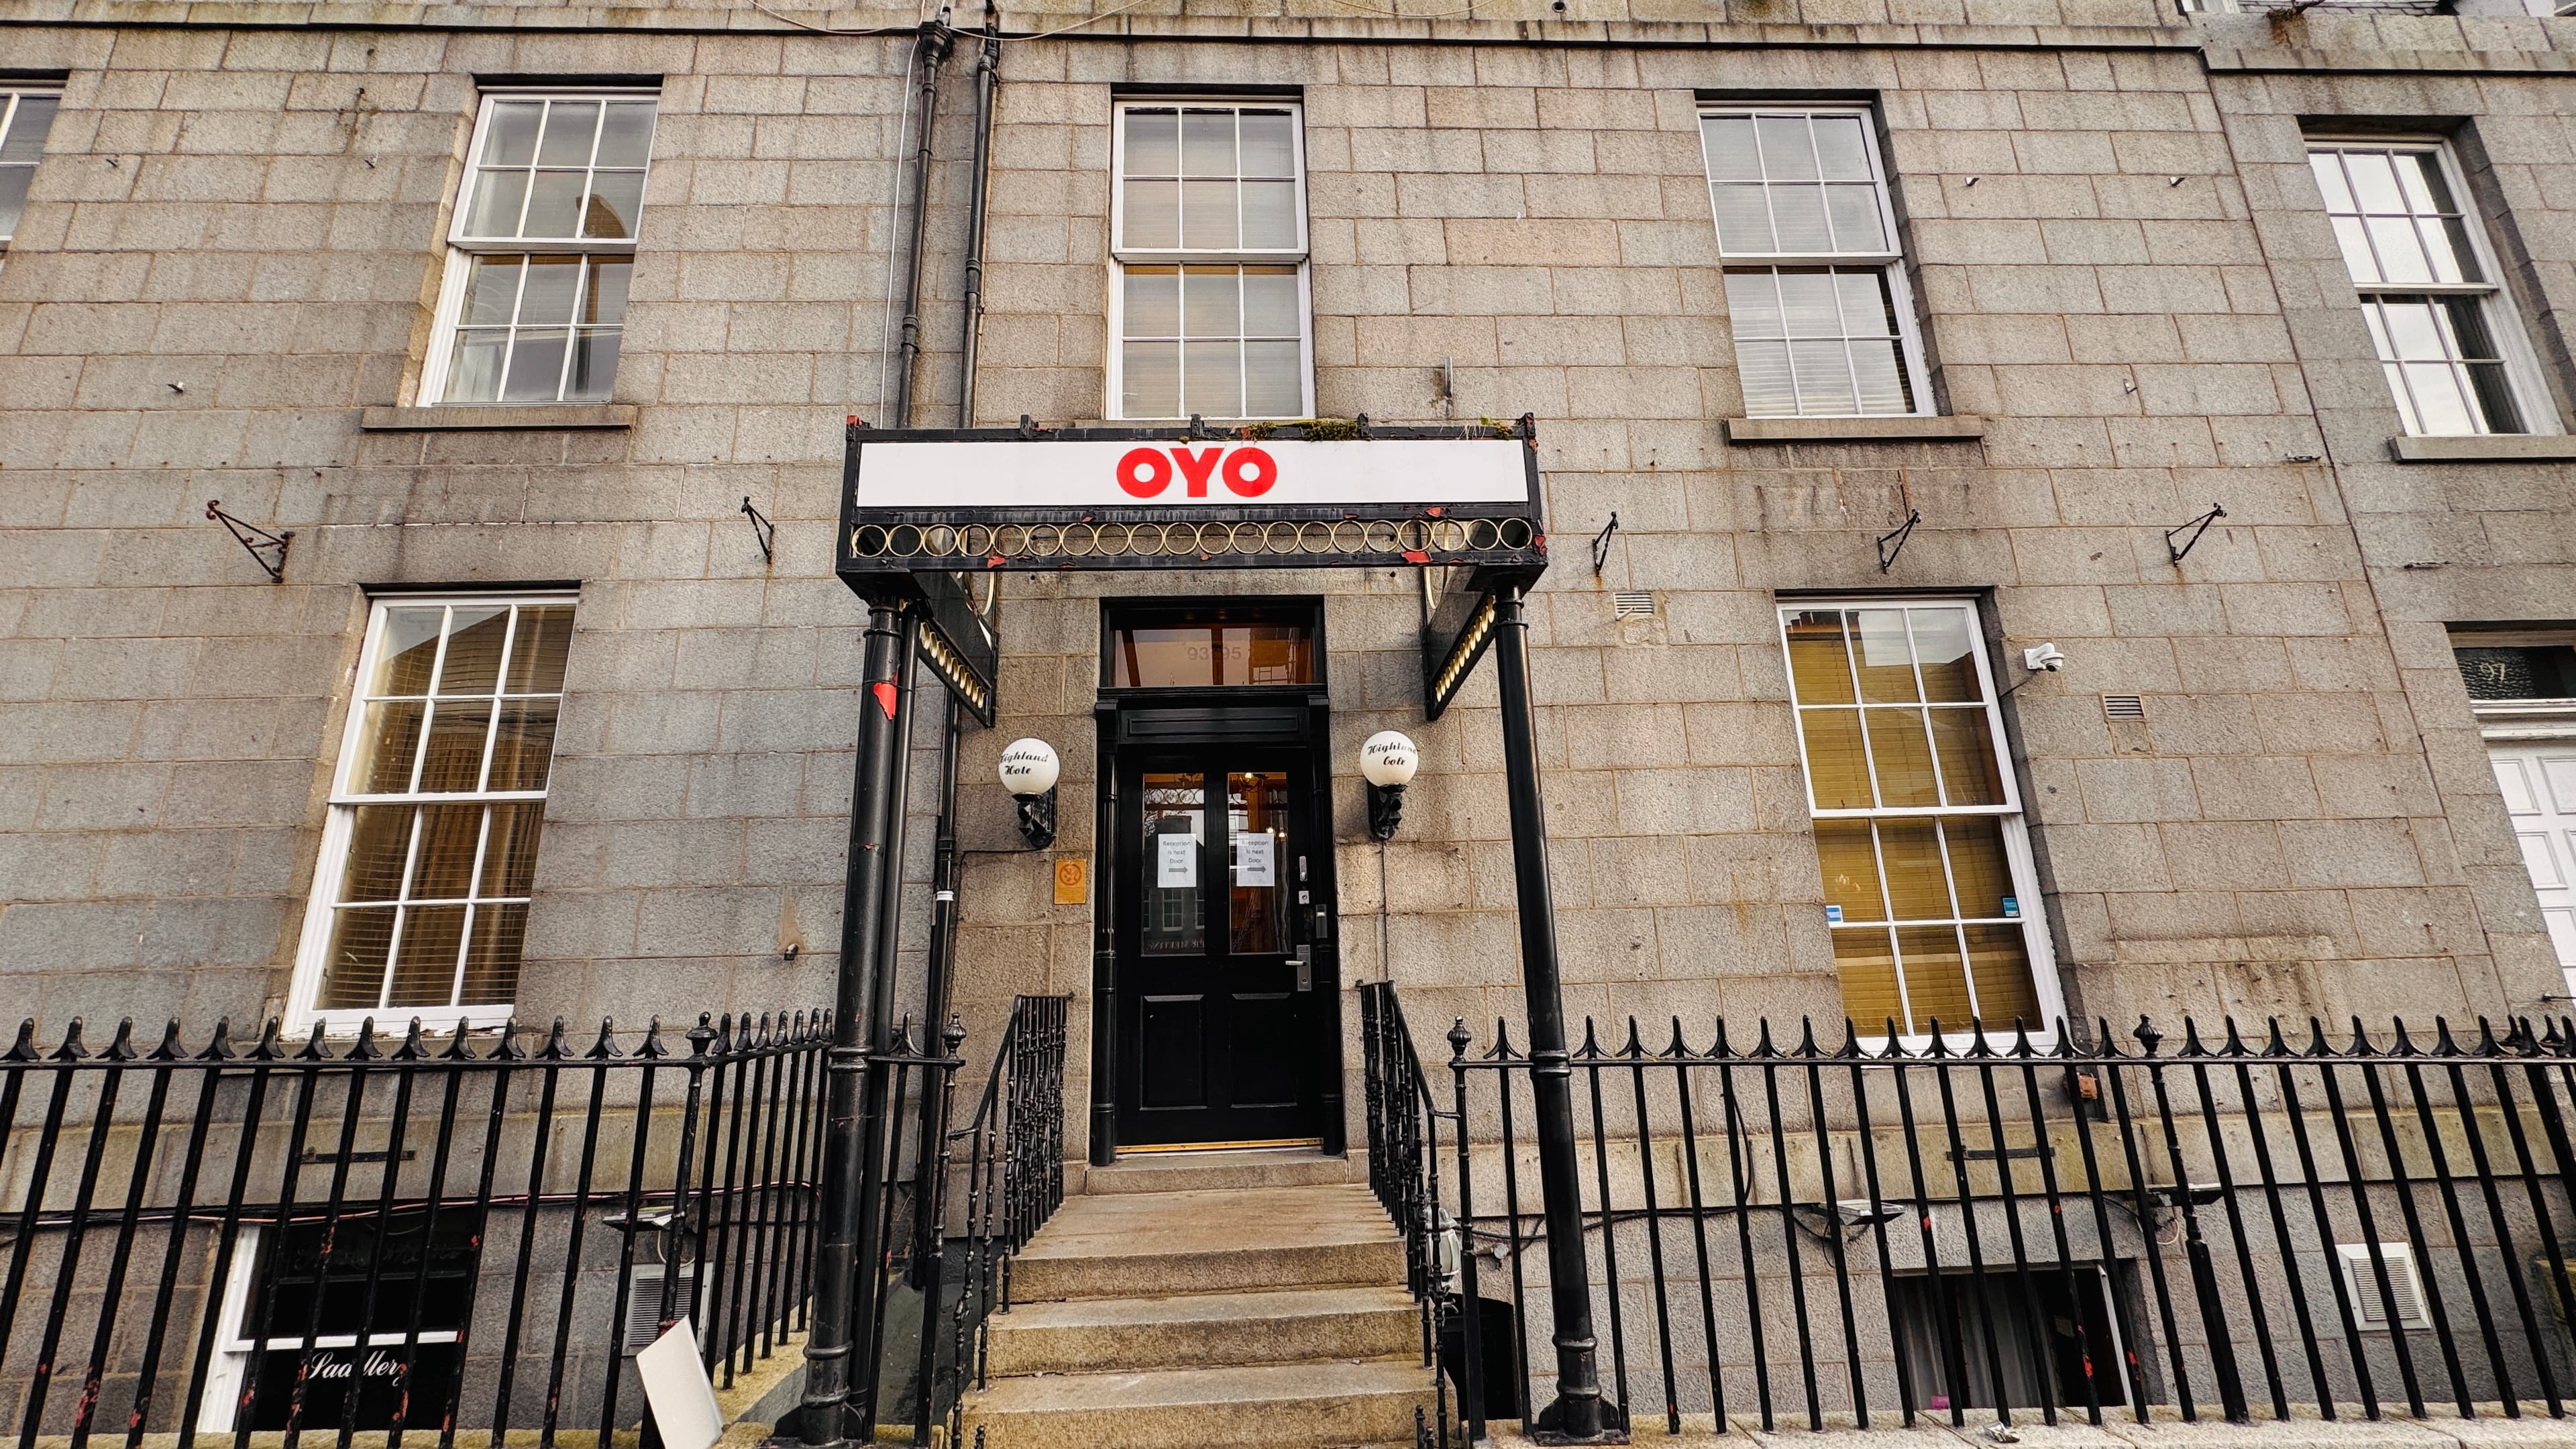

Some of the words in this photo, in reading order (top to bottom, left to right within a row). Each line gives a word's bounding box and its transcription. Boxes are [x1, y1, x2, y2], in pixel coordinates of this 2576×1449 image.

[1116, 447, 1278, 498] OYO
[1187, 647, 1242, 660] 9395
[2479, 662, 2506, 682] 97
